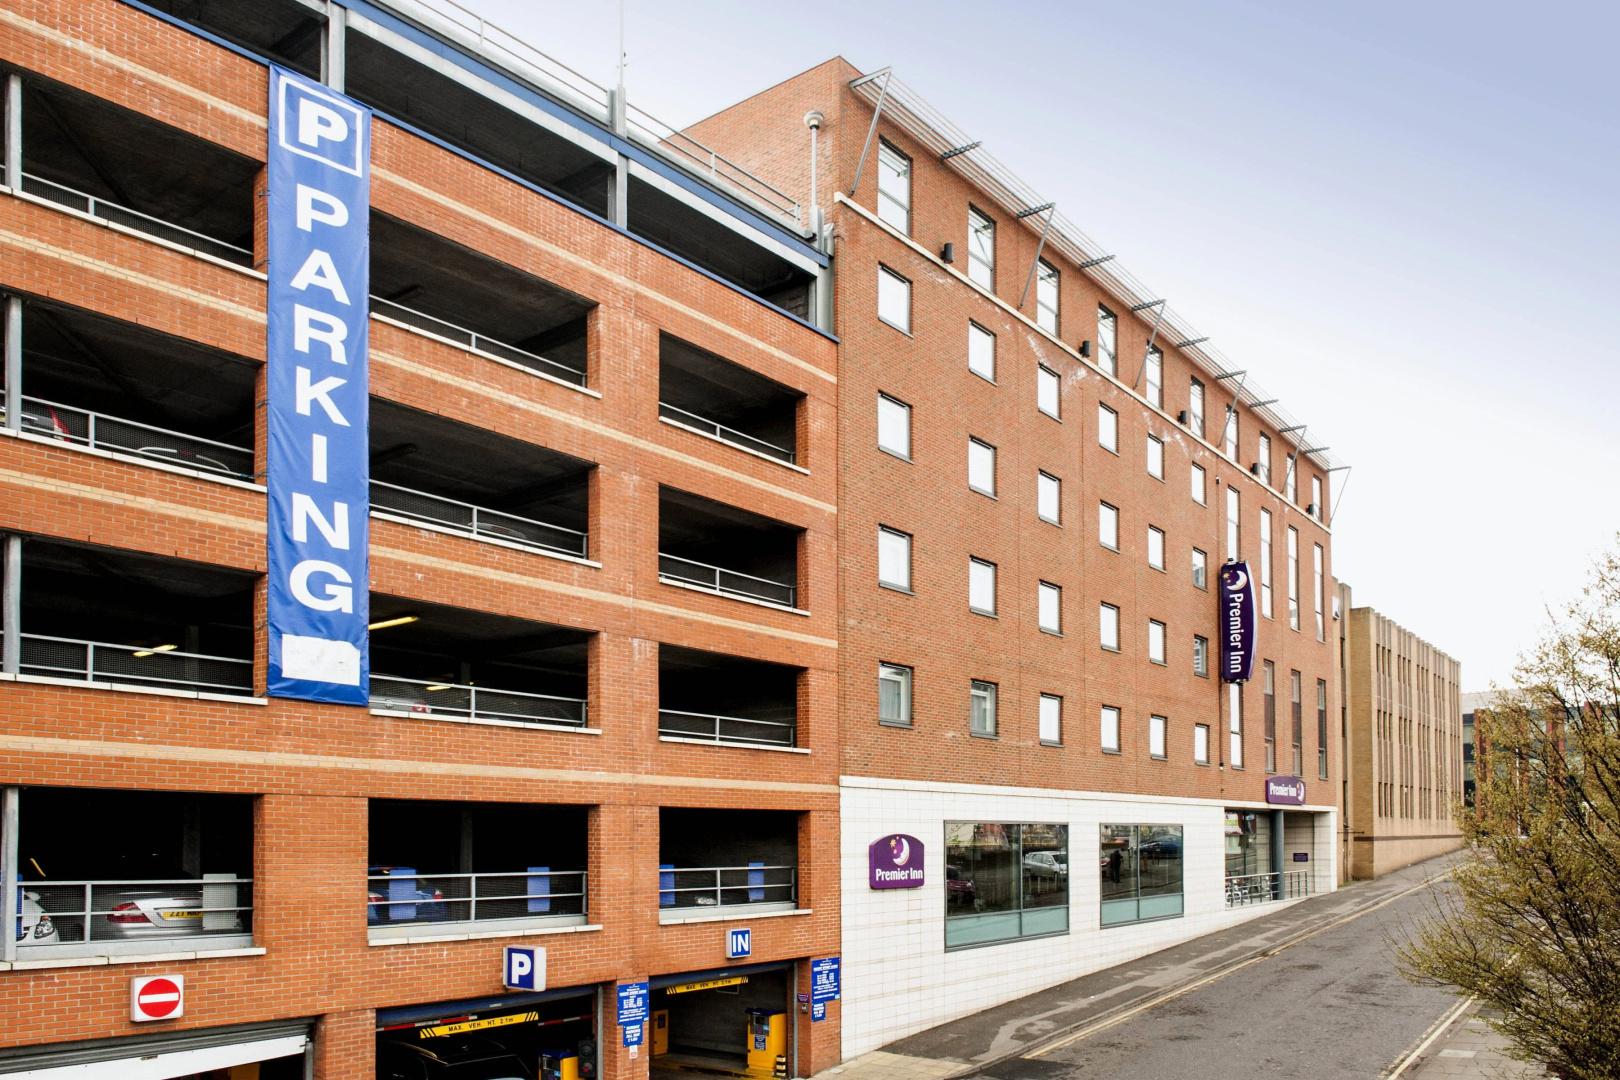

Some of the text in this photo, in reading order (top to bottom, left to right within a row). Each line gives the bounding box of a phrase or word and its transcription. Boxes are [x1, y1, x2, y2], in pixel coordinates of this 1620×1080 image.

[298, 97, 348, 148] P
[289, 183, 353, 614] PARKING
[1229, 593, 1245, 673] Premier Inn
[1270, 782, 1296, 796] Premier Inn
[875, 867, 923, 882] Premier Inn
[732, 933, 750, 953] IN
[511, 952, 532, 984] P
